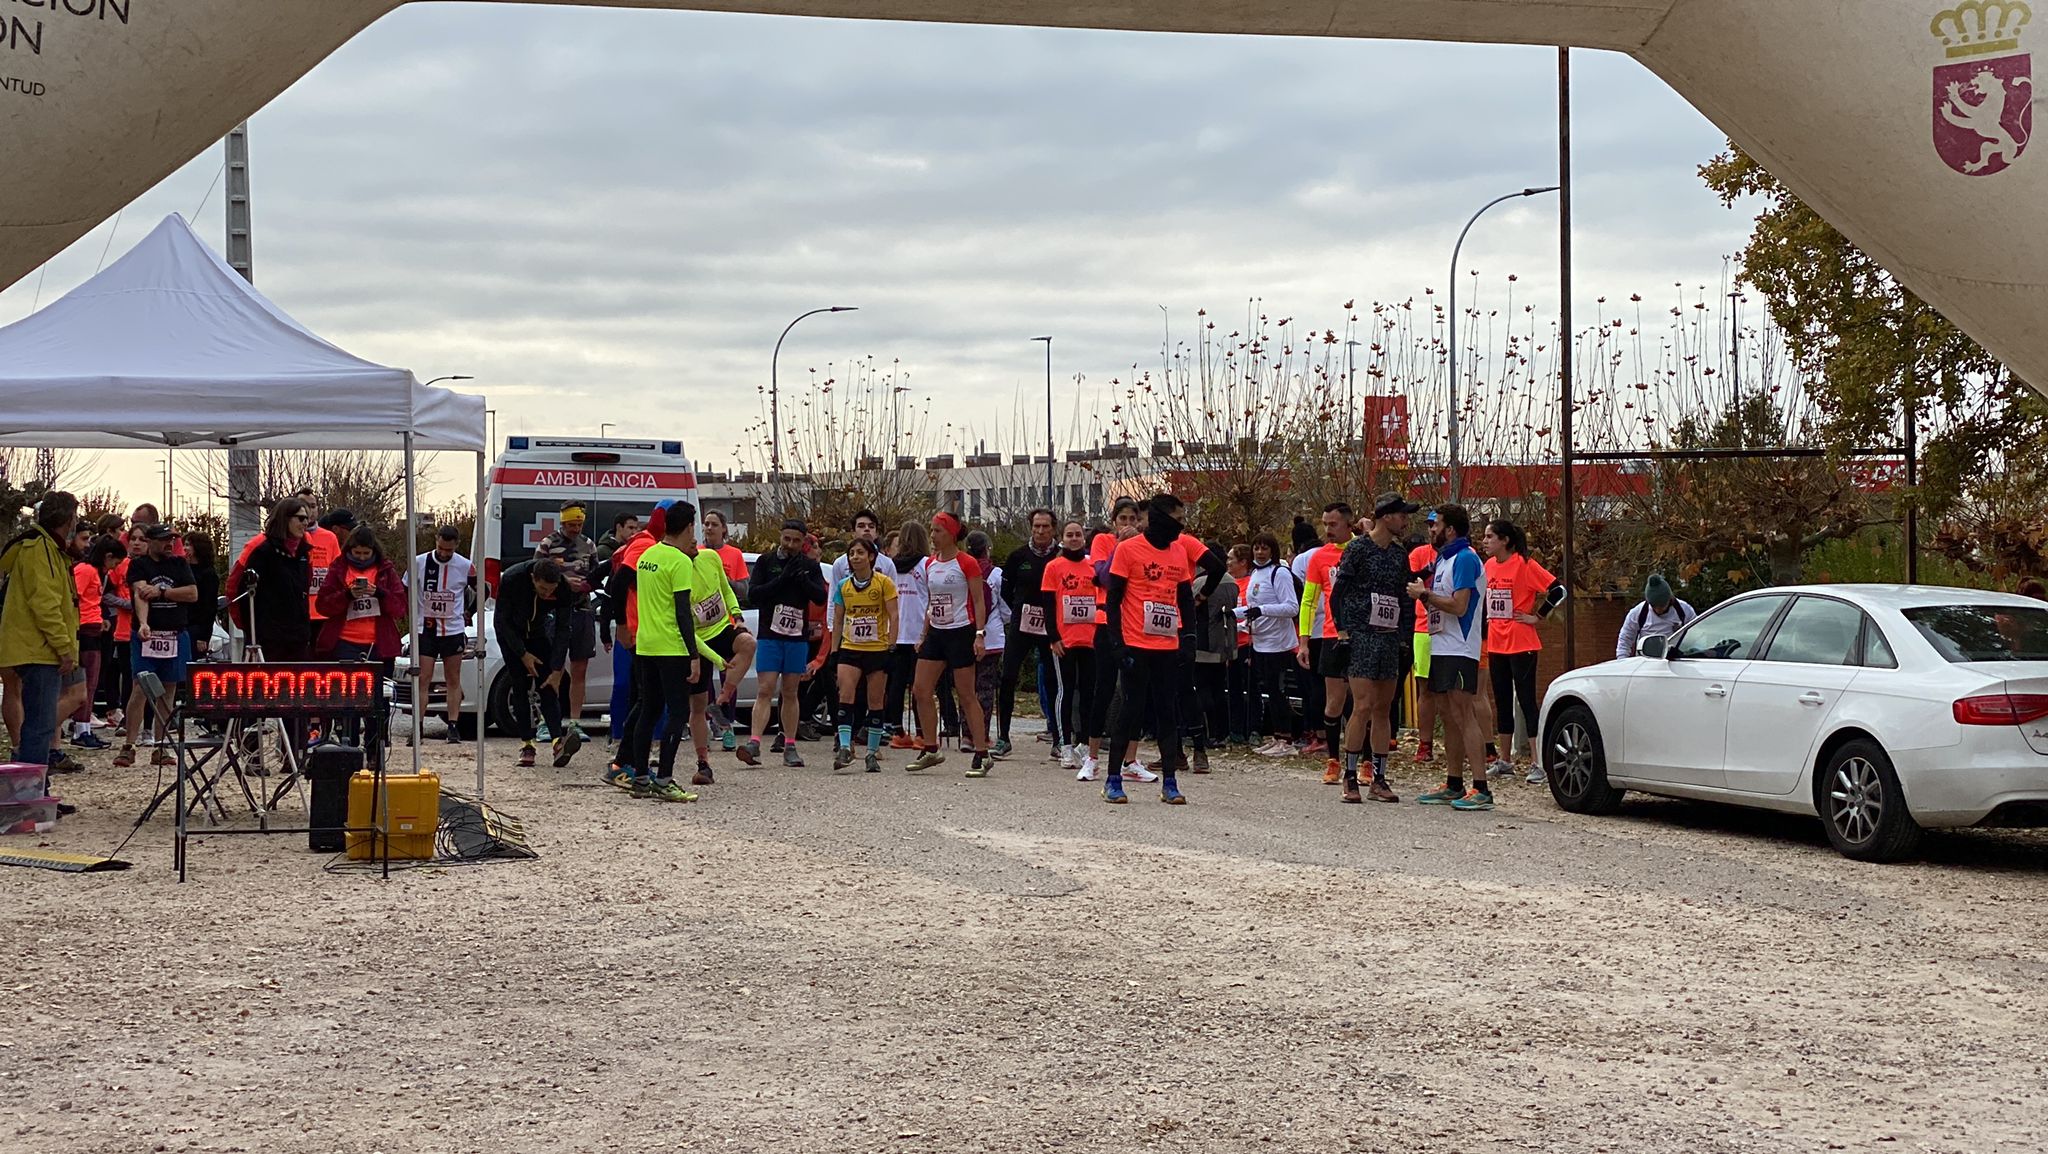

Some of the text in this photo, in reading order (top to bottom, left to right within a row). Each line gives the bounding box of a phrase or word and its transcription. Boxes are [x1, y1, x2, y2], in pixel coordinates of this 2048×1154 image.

[534, 471, 657, 488] AMBULANCIA
[352, 599, 372, 611] 463
[431, 602, 447, 612] 441
[1491, 600, 1505, 611] 418
[705, 604, 720, 620] 440
[931, 606, 945, 617] 451
[1071, 606, 1089, 617] 457
[1378, 607, 1395, 619] 466
[779, 616, 797, 629] 475
[1029, 616, 1045, 628] 477
[1152, 614, 1172, 629] 448
[855, 625, 872, 637] 472
[149, 640, 170, 651] 403
